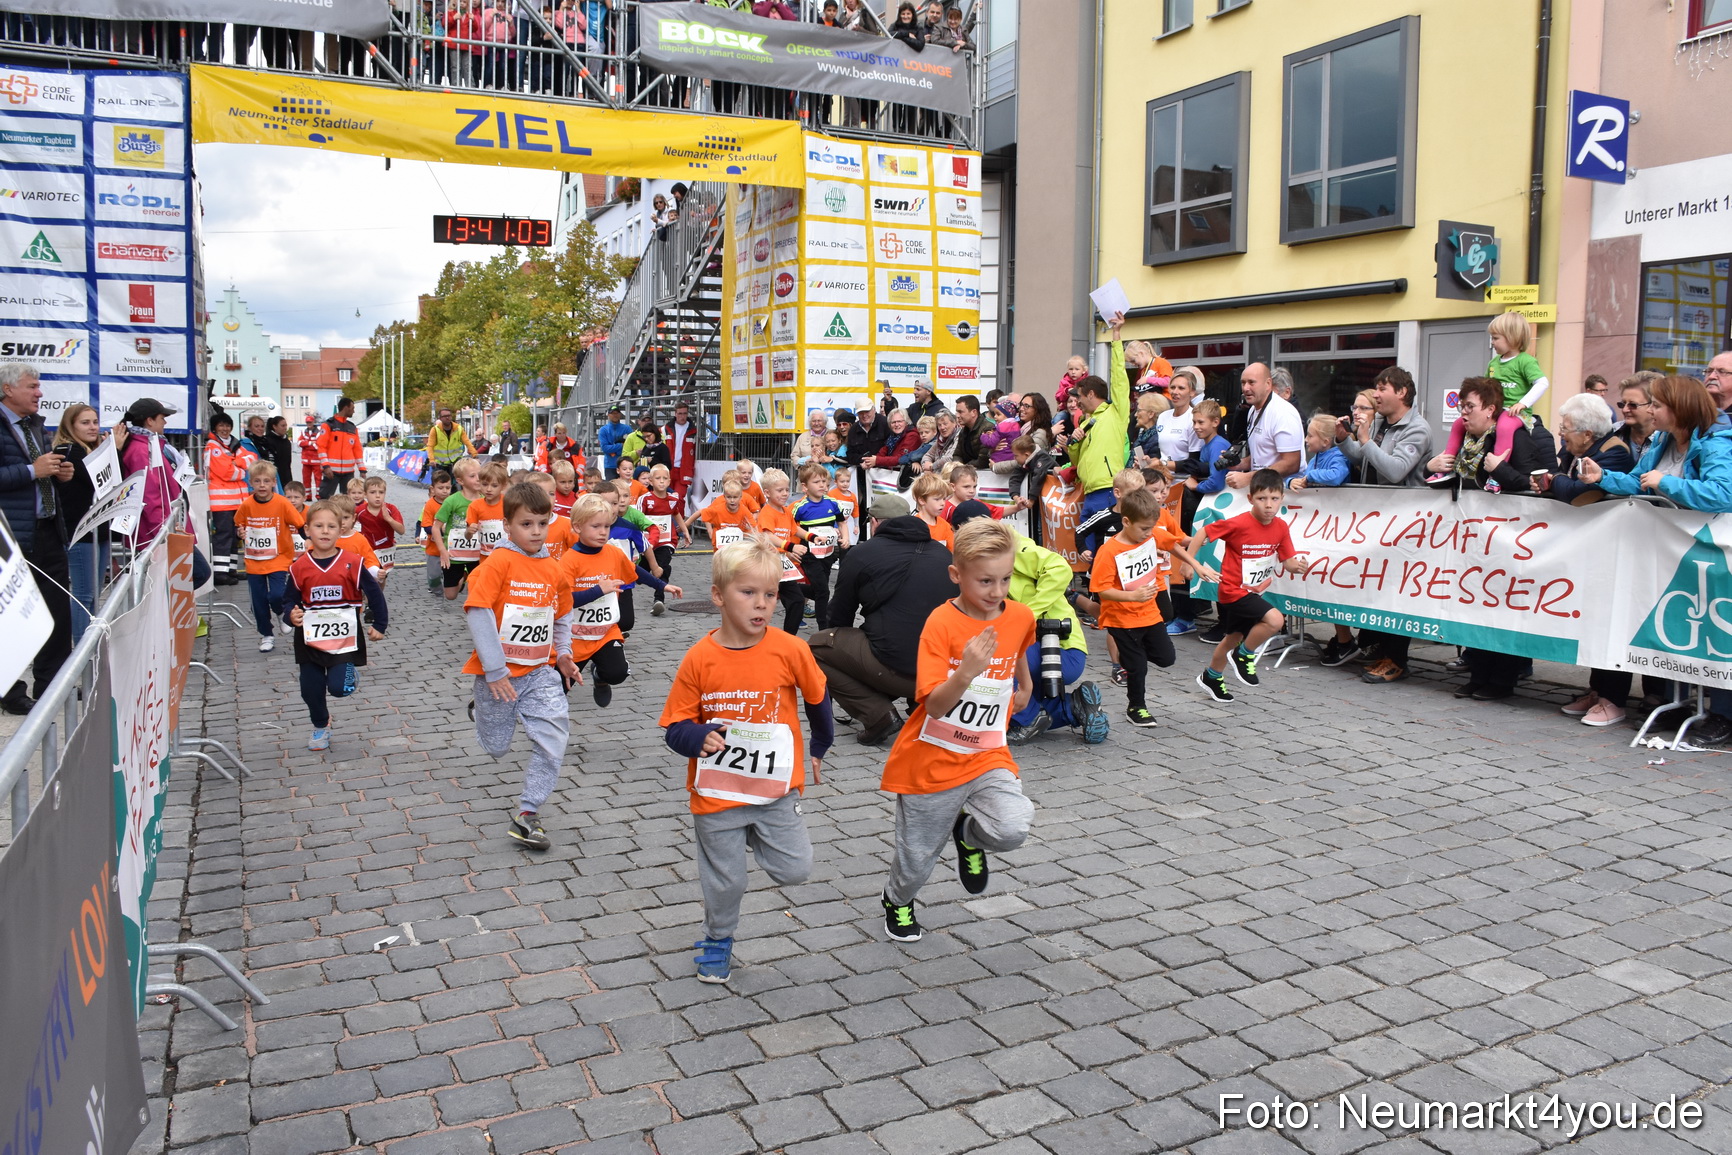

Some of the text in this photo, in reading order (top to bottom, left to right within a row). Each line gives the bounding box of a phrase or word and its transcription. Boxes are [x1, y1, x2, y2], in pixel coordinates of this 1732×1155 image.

[659, 20, 769, 53] BOCK
[659, 43, 774, 64] inspired by smart concepts
[786, 42, 953, 78] OFFICE INDUSTRY LOUNGE
[817, 62, 933, 90] www.bockonline.de
[43, 86, 71, 94] CODE
[42, 93, 76, 102] CLINIC
[228, 107, 374, 130] Neumarkter Stadtlauf
[454, 108, 592, 156] ZIEL
[2, 133, 72, 146] Neumarkter Tagblatt
[118, 137, 161, 155] Burgis
[662, 145, 778, 163] Neumarkter Stadtlauf
[836, 165, 860, 173] energie
[21, 191, 80, 202] VARIOTEC
[874, 198, 909, 211] swn
[1624, 195, 1732, 225] Unterer Markt 1
[142, 208, 180, 217] energie
[101, 244, 160, 258] charivari
[905, 246, 926, 255] CLINIC
[1468, 243, 1486, 274] G2
[824, 281, 865, 291] VARIOTEC
[890, 279, 918, 292] Burgis
[1494, 287, 1537, 295] Startnummern-
[129, 305, 153, 316] Braun
[905, 334, 930, 342] energie
[2, 342, 56, 357] swn
[123, 357, 164, 365] Neumarkter
[116, 363, 172, 374] Lammsbräu
[881, 364, 907, 372] Neumarkter
[939, 367, 973, 376] charivari
[232, 400, 265, 408] Laufsport
[95, 463, 112, 487] swn
[1303, 509, 1381, 545] UNS
[249, 537, 271, 548] 7169
[453, 538, 477, 549] 7247
[720, 535, 740, 544] 7277
[1125, 556, 1154, 579] 7251
[510, 580, 545, 589] Neumarkter
[1399, 560, 1581, 619] BESSER.
[312, 588, 341, 600] rytas
[509, 590, 538, 598] Stadtlauf
[578, 607, 612, 623] 7265
[1285, 600, 1356, 622] Service-Line:
[311, 622, 350, 638] 7233
[510, 624, 548, 643] 7285
[1627, 652, 1648, 666] Jura
[1652, 656, 1699, 676] Gebäude
[973, 685, 1000, 695] BOCK
[740, 730, 771, 740] BOCK
[714, 744, 776, 775] 7211
